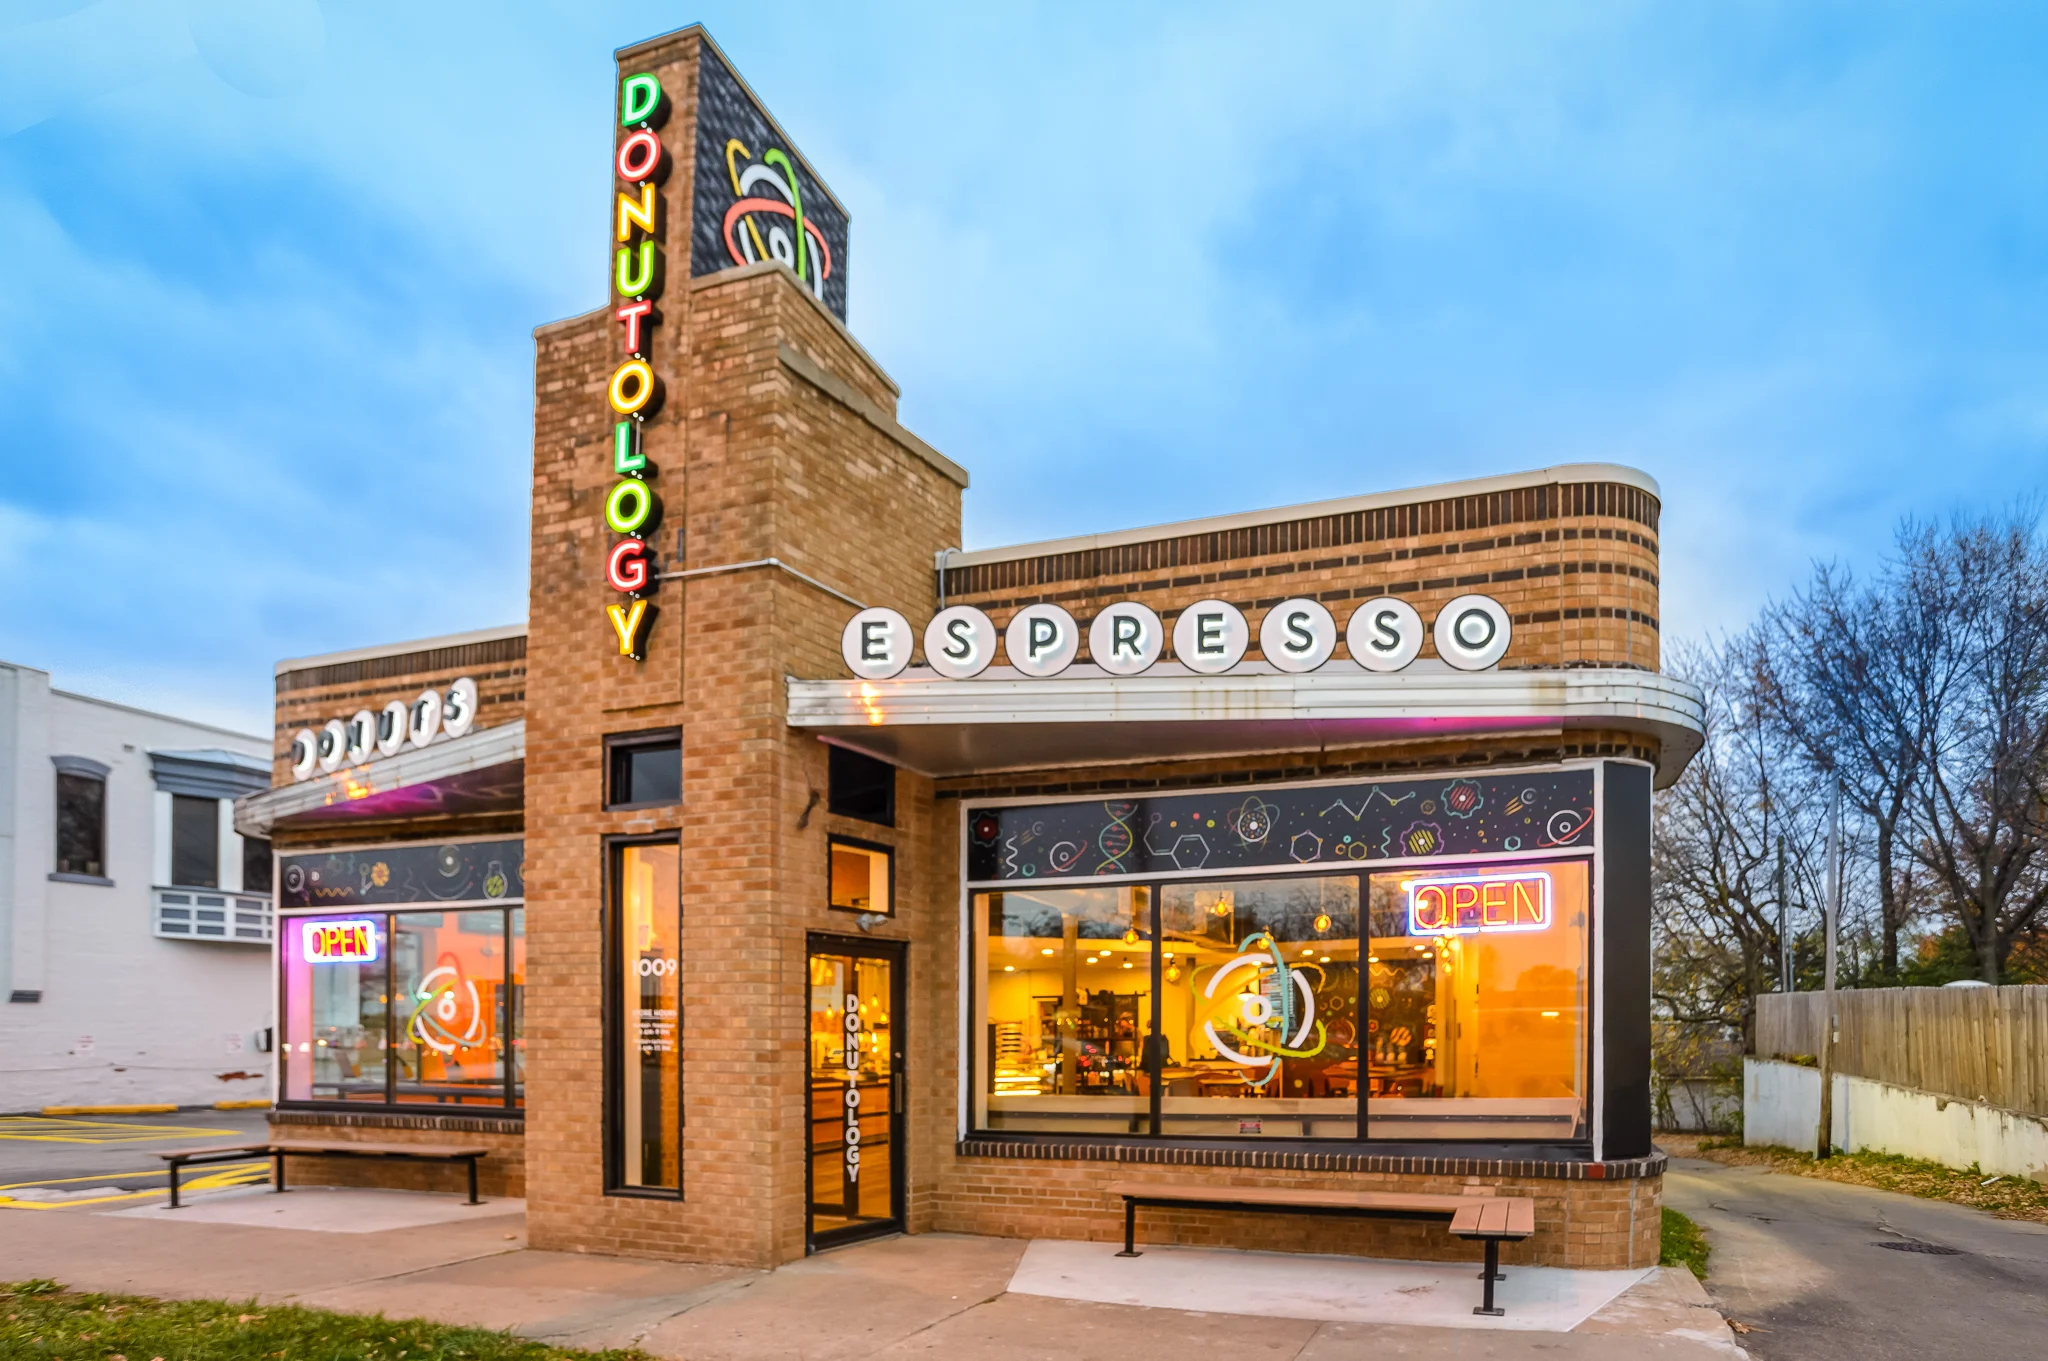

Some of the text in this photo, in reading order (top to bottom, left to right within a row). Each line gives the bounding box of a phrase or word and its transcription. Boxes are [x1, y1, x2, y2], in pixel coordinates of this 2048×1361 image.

[605, 73, 661, 656] DONUTOLOGY
[861, 607, 1498, 661] ESPRESSO
[288, 688, 468, 767] DONUTS
[1415, 878, 1544, 929] OPEN
[309, 926, 370, 957] OPEN
[631, 958, 677, 977] 1009
[845, 994, 861, 1182] DONUTOLOGY
